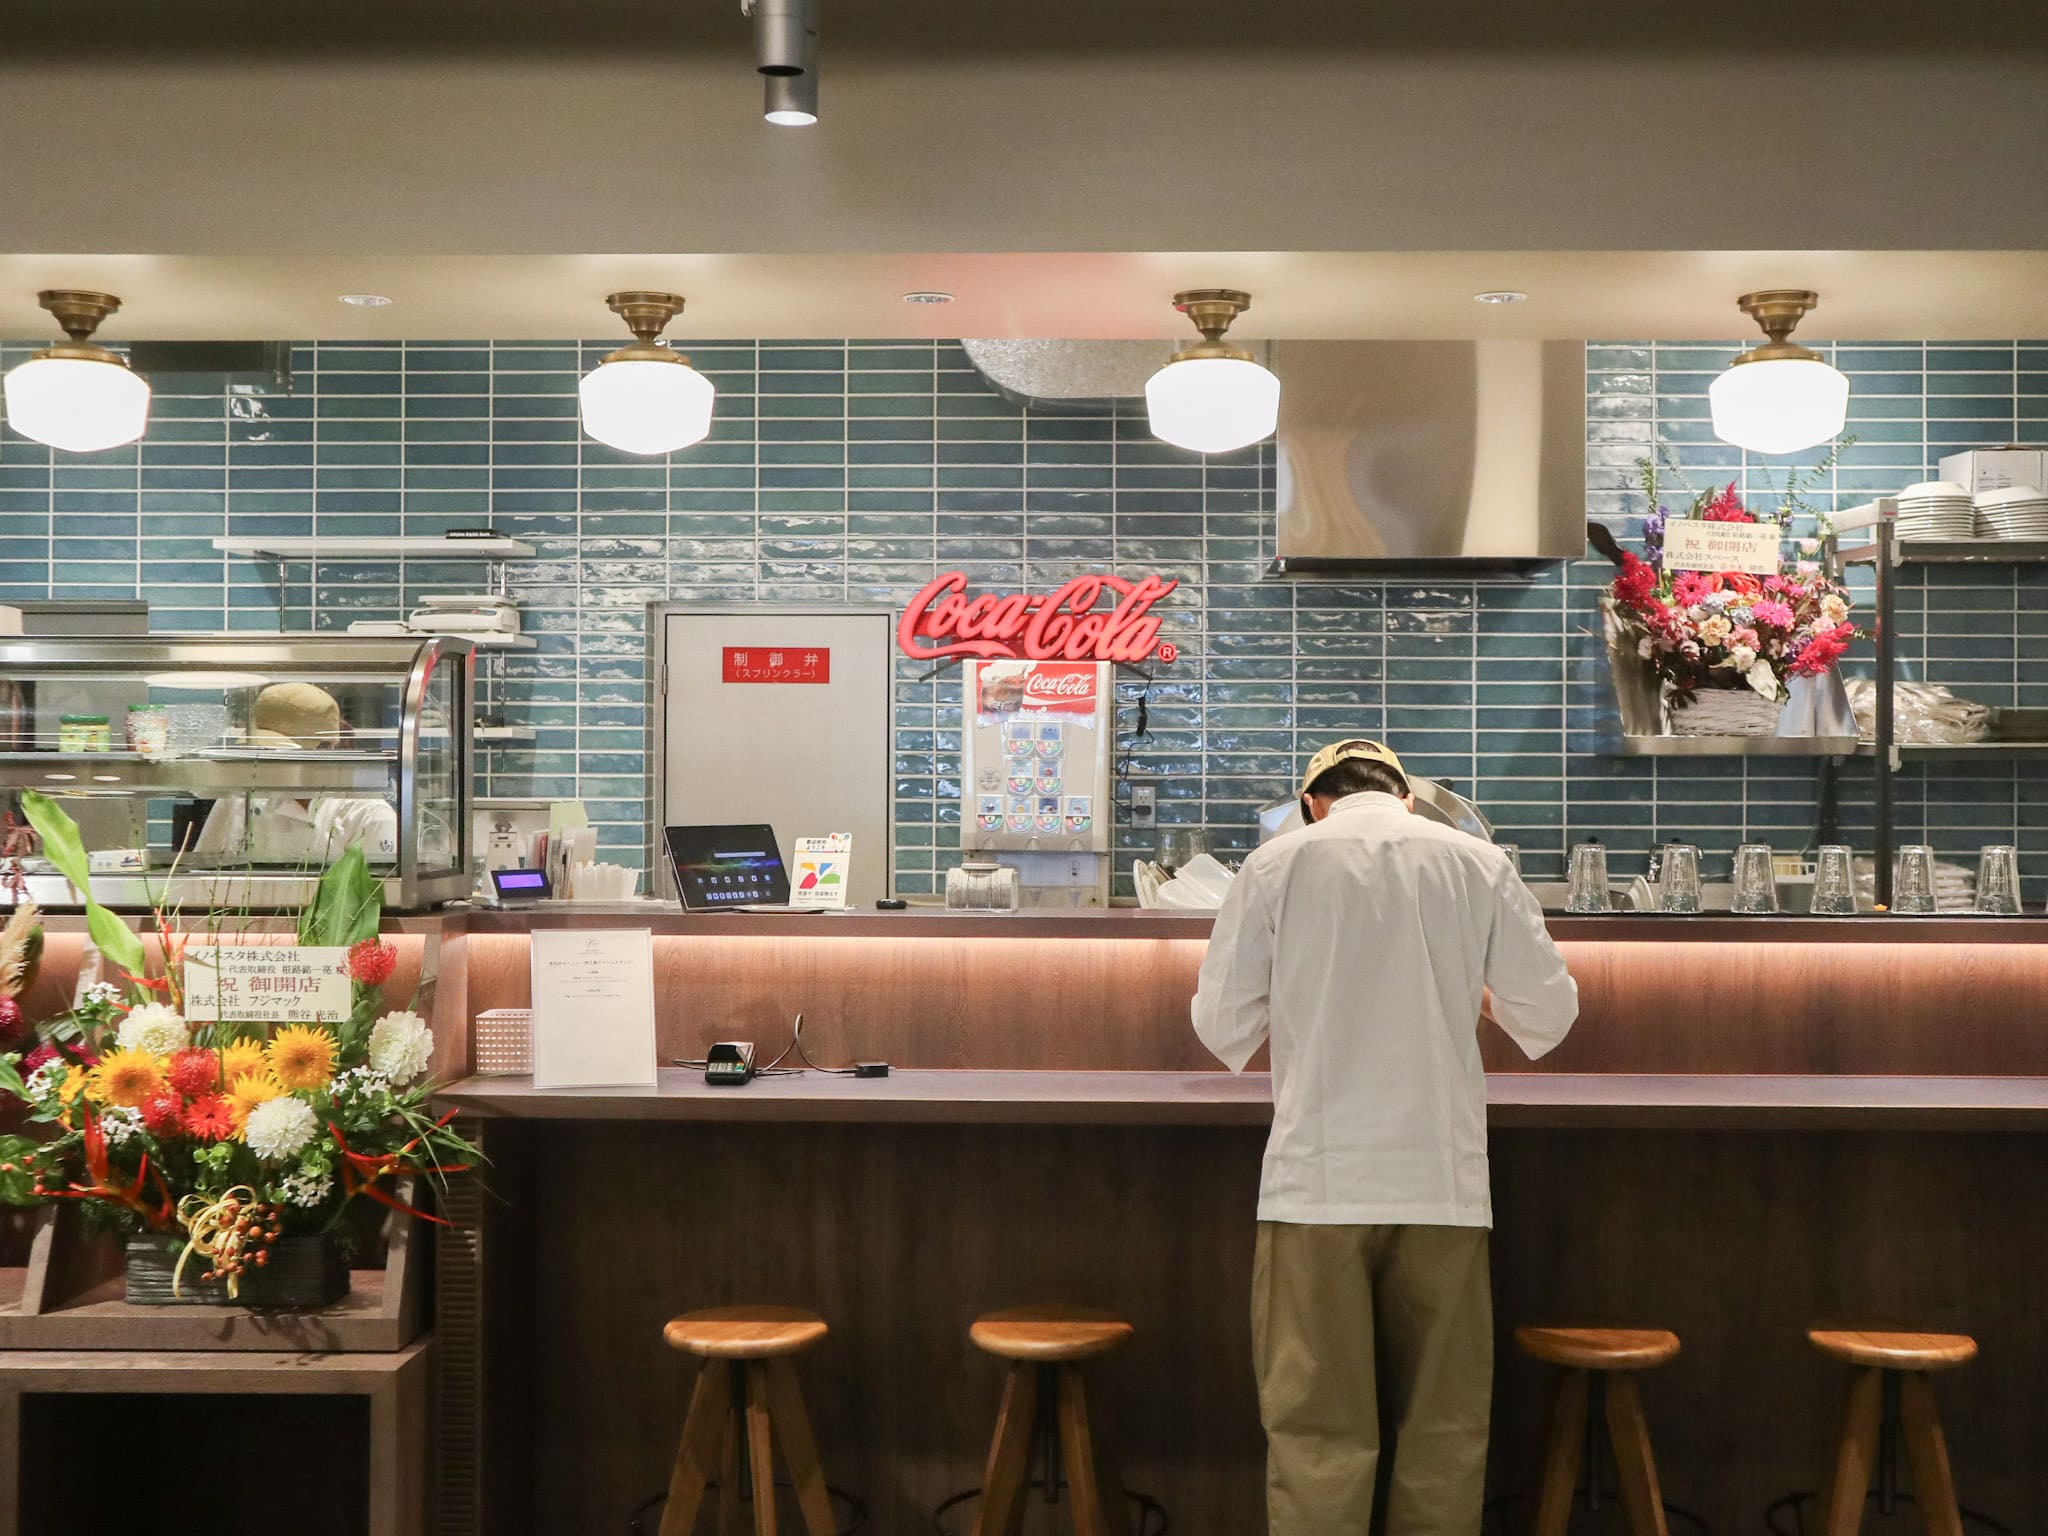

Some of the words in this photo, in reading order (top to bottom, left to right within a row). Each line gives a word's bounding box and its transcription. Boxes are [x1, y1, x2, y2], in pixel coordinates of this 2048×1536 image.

[897, 570, 1178, 662] Coca-Cola
[733, 652, 818, 667] 制御弁
[1026, 673, 1094, 696] Coca-Cola
[248, 976, 322, 993] 御開店
[191, 994, 241, 1008] 株式会社
[248, 994, 301, 1008] フジマック
